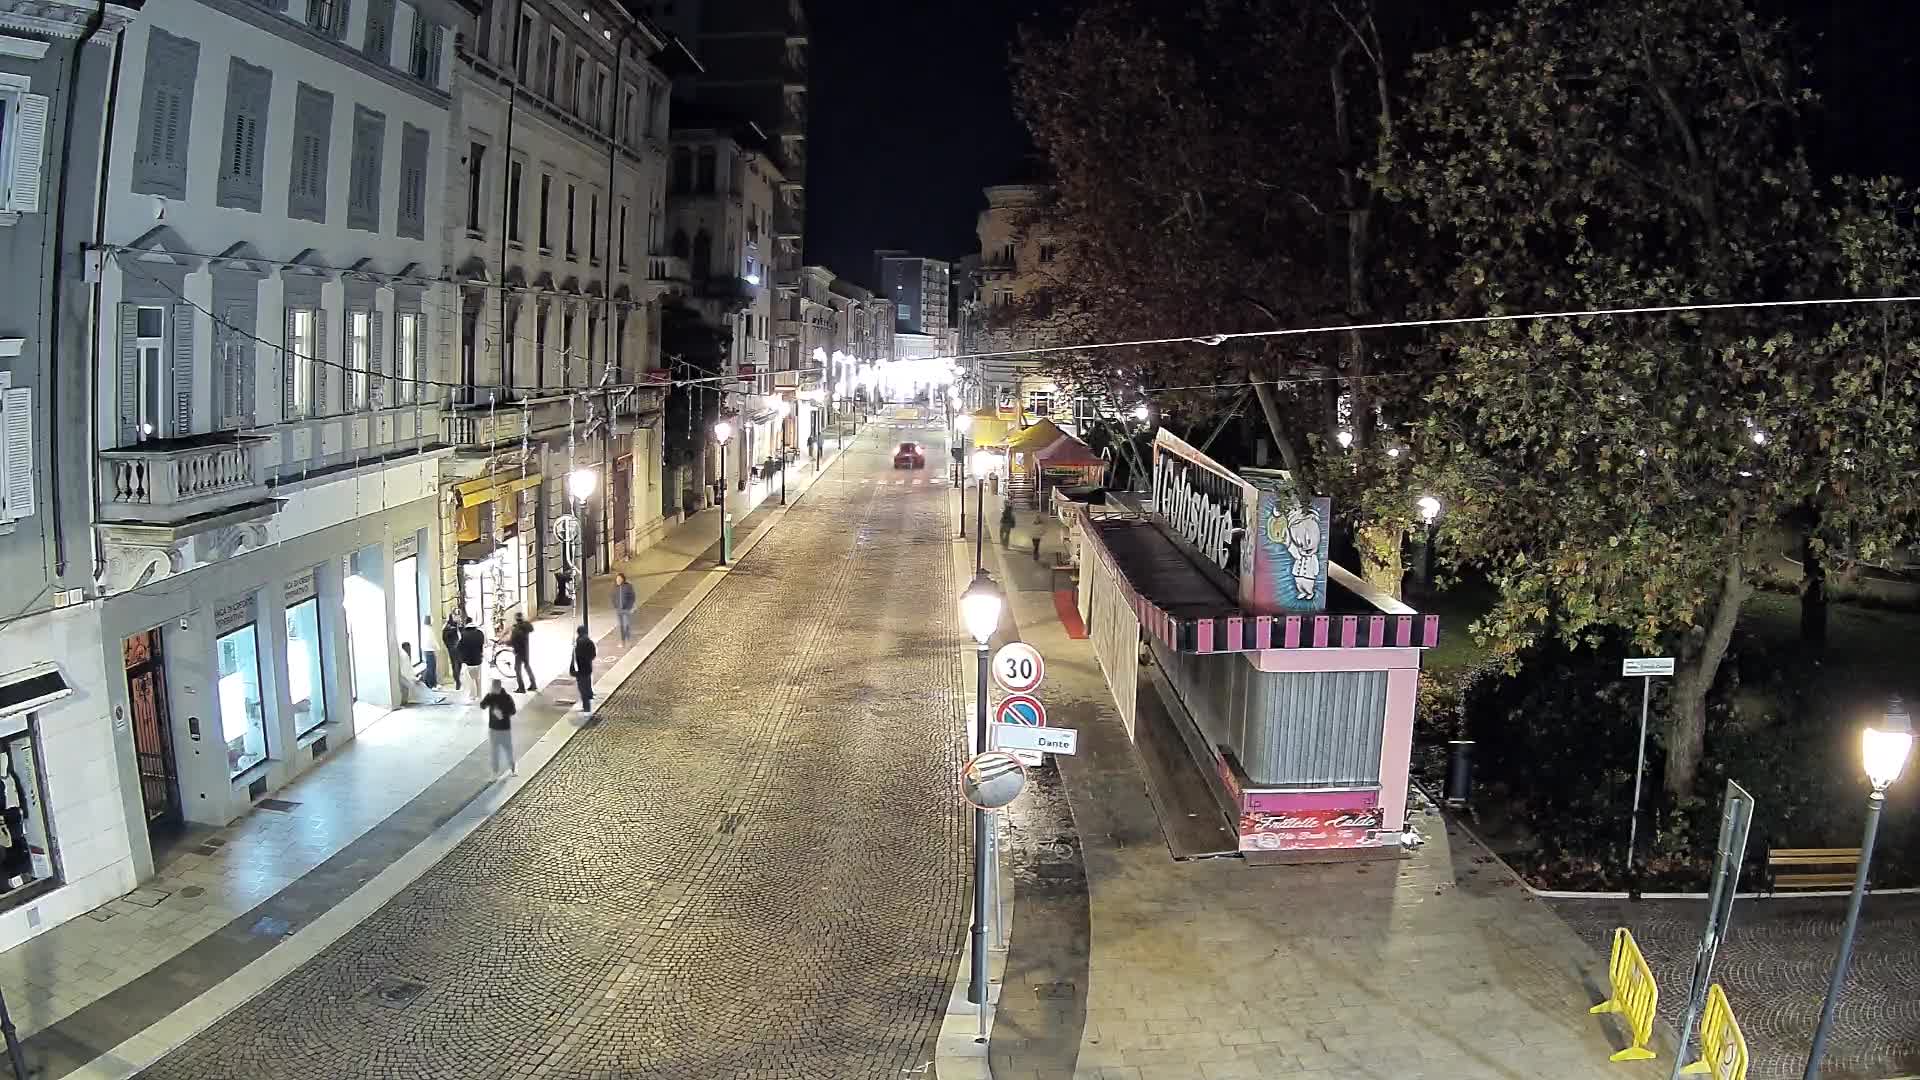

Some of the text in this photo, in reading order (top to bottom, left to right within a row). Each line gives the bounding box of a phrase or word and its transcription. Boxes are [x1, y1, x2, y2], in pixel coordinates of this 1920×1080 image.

[1162, 458, 1233, 570] Golosone
[1006, 658, 1032, 679] 30
[1038, 737, 1070, 749] Dante
